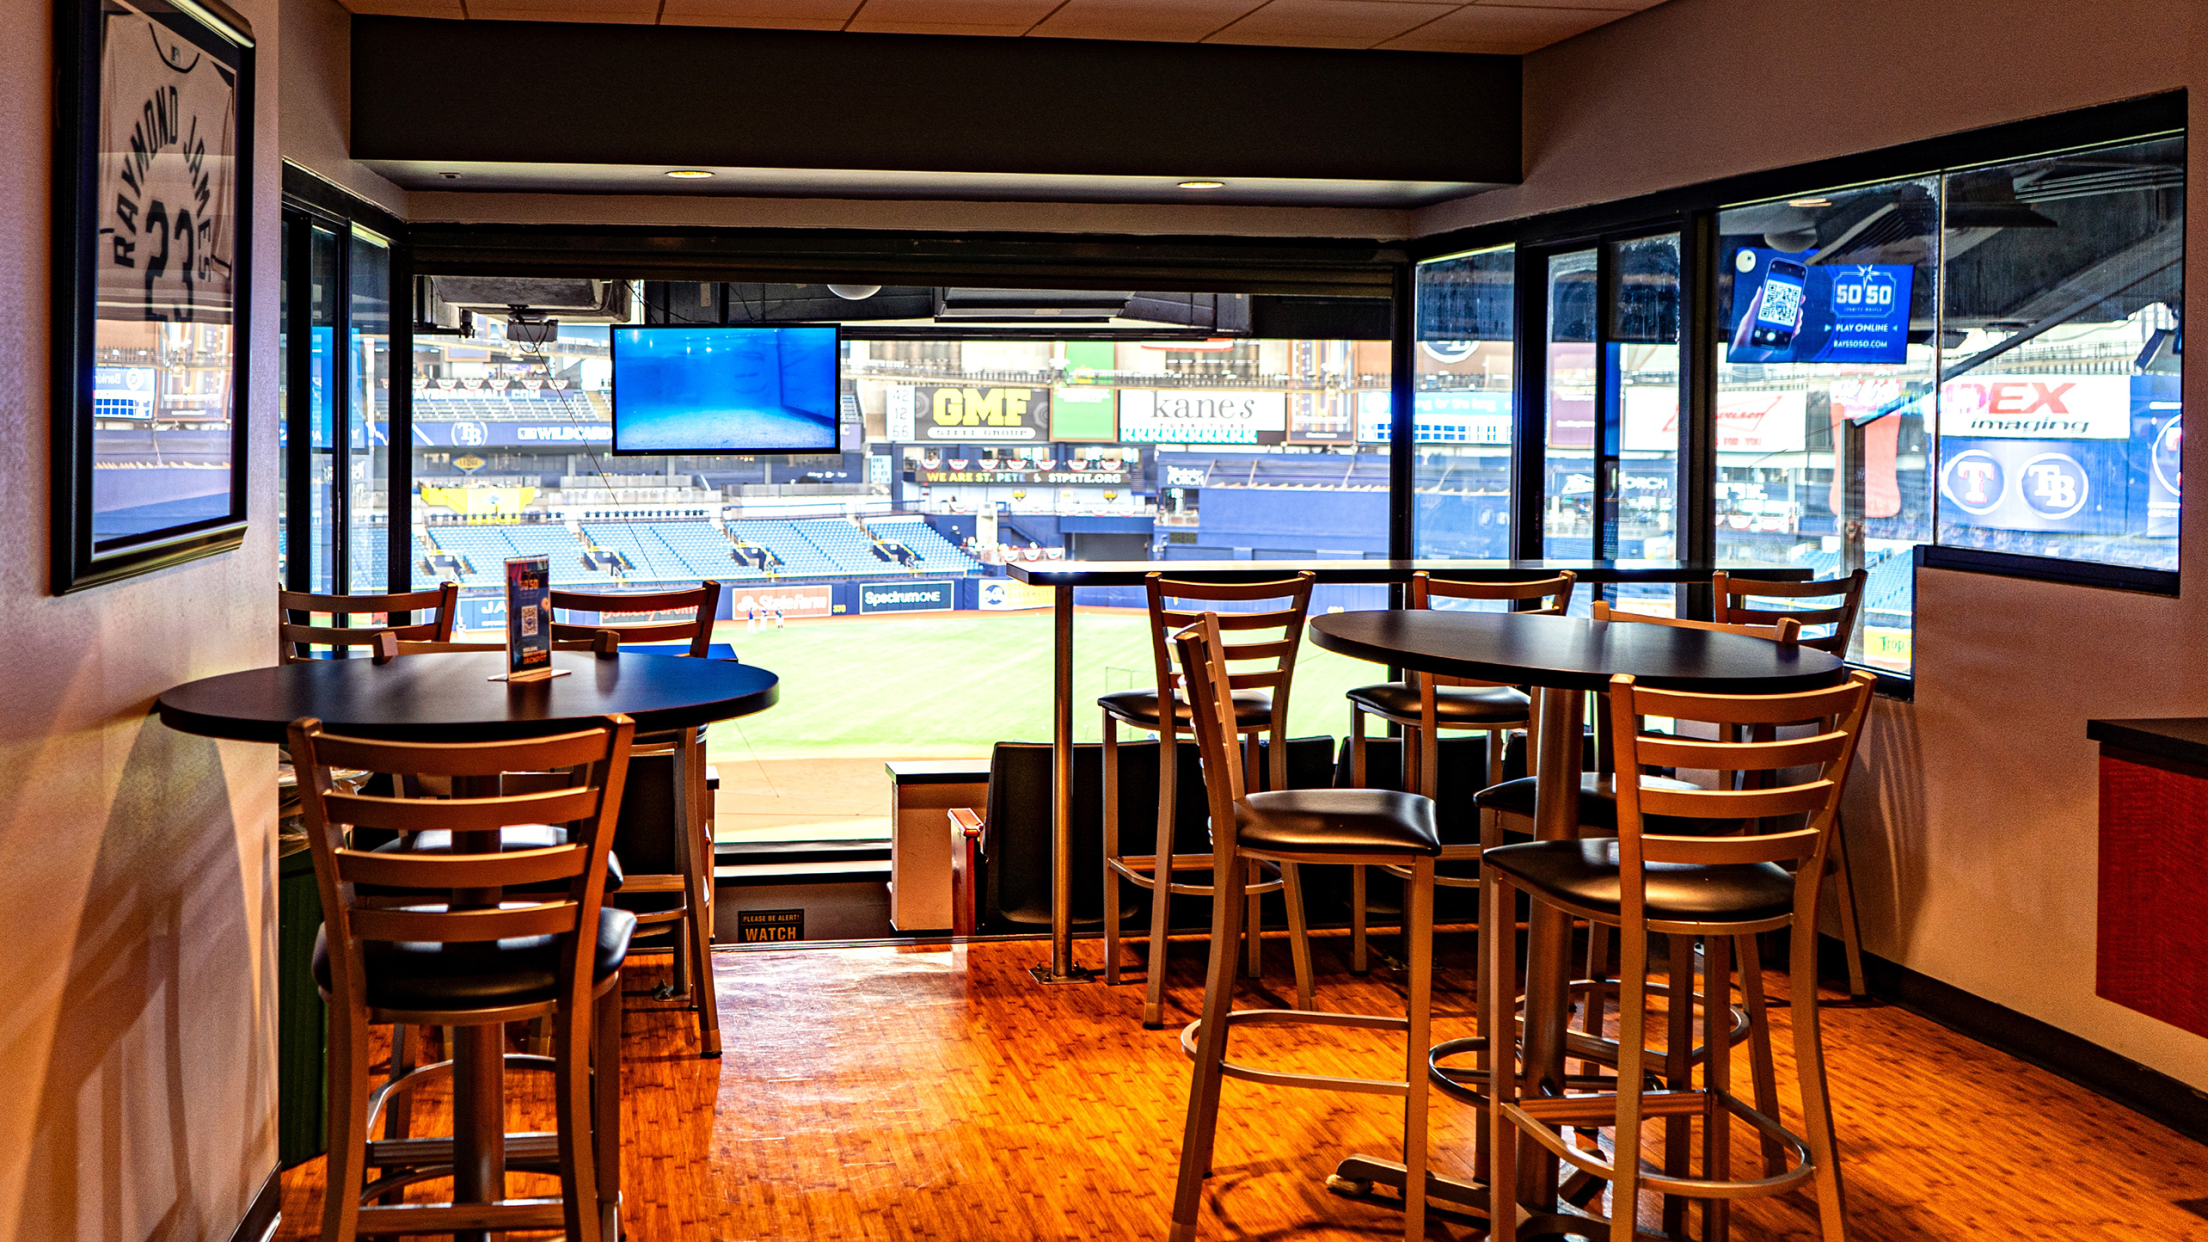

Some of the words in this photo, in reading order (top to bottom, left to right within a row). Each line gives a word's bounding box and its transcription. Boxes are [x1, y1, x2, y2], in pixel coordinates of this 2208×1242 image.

[114, 85, 178, 268] RAYMOND
[183, 115, 211, 283] JAMES
[145, 200, 194, 322] 23
[1836, 284, 1862, 304] 50
[1865, 284, 1892, 305] 50
[1836, 323, 1854, 332] PLAY
[1855, 323, 1888, 332] ONLINE
[933, 388, 1031, 427] GMF
[1971, 416, 2090, 434] imaging
[927, 472, 946, 482] WE
[949, 472, 973, 482] ARE
[997, 472, 1026, 482] PETE
[1048, 472, 1122, 483] STPETE.ORG
[1879, 635, 1905, 652] Trop
[743, 915, 766, 923] PLEASE
[767, 914, 776, 922] BE
[745, 926, 797, 941] WATCH
